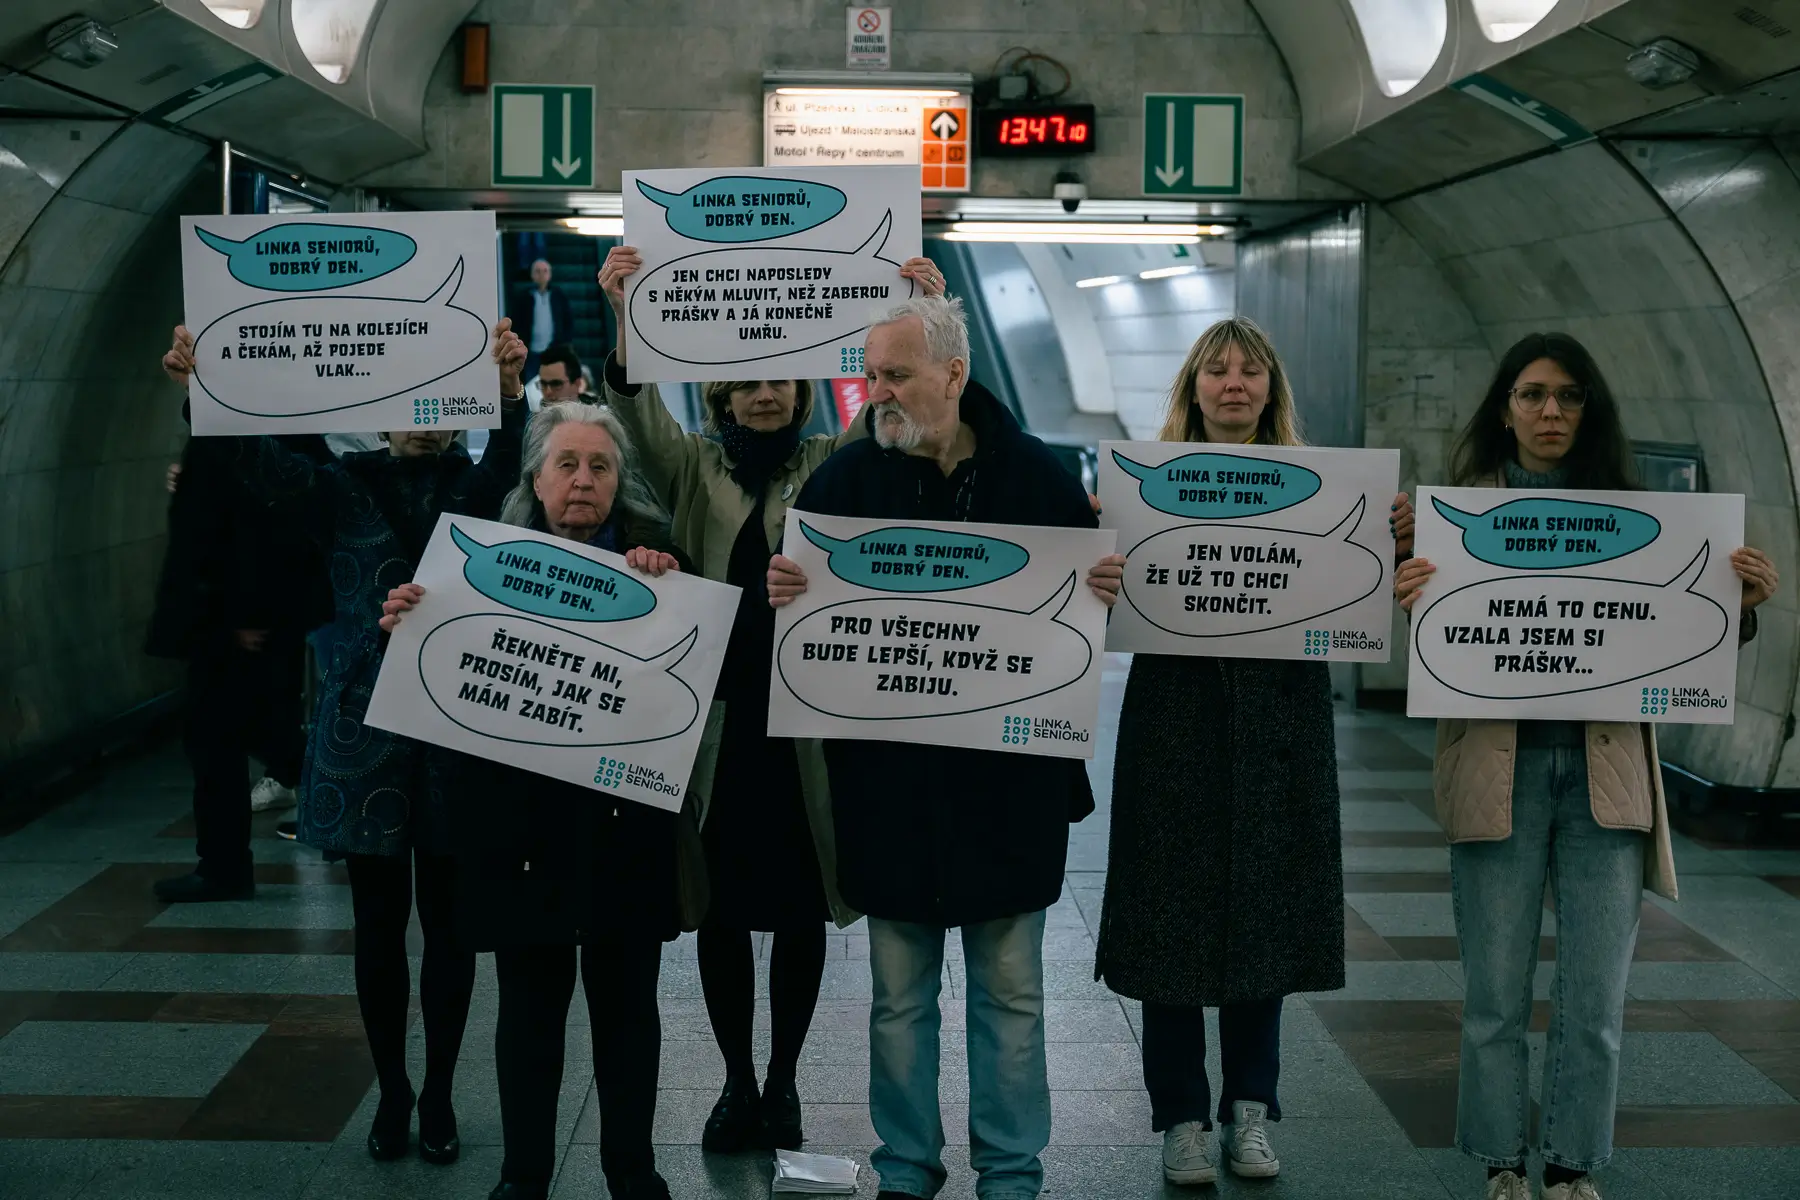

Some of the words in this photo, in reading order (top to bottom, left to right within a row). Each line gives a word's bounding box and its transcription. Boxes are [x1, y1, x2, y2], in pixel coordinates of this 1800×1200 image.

[774, 146, 807, 156] Motol
[856, 148, 904, 157] centrum
[693, 194, 736, 207] LINKA
[742, 188, 811, 208] SENIORŮ,
[705, 210, 754, 227] DOBRÝ
[761, 213, 795, 226] DEN.
[256, 241, 301, 255] LINKA
[306, 235, 380, 256] SENIORŮ,
[269, 257, 321, 275] DOBRÝ
[328, 260, 363, 274] DEN.
[673, 270, 698, 282] JEN
[706, 269, 739, 282] CHCI
[747, 267, 832, 281] NAPOSLEDY
[649, 290, 657, 302] S
[665, 286, 715, 302] NĚKÝM
[723, 288, 781, 303] MLUVIT,
[788, 284, 815, 300] NEŽ
[822, 286, 889, 299] ZABEROU
[662, 305, 719, 322] PRÁŠKY
[726, 308, 735, 320] A
[743, 304, 759, 320] JÁ
[766, 303, 832, 319] KONEČNĚ
[239, 321, 296, 338] STOJÍM
[302, 324, 322, 337] TU
[330, 324, 350, 336] NA
[357, 319, 427, 336] KOLEJÍCH
[739, 327, 786, 340] UMŘU.
[222, 347, 231, 359] A
[239, 342, 296, 361] ČEKÁM,
[303, 341, 322, 357] AŽ
[329, 343, 385, 356] POJEDE
[842, 356, 864, 364] 200
[316, 364, 370, 377] VLAK...
[442, 397, 477, 406] LINKA
[443, 403, 494, 415] SENIORŮ
[1168, 469, 1210, 483] LINKA
[1217, 469, 1285, 490] SENIORŮ,
[1179, 487, 1228, 503] DOBRÝ
[1234, 491, 1267, 505] DEN.
[1493, 516, 1539, 530] LINKA
[1546, 512, 1621, 536] SENIORŮ,
[1505, 534, 1559, 552] DOBRÝ
[1565, 539, 1602, 553] DEN.
[860, 542, 907, 556] LINKA
[914, 544, 990, 564] SENIORŮ,
[1187, 544, 1221, 561] JEN
[1230, 542, 1302, 568] VOLÁM,
[496, 551, 541, 575] LINKA
[547, 565, 618, 600] SENIORŮ,
[871, 560, 925, 576] DOBRÝ
[932, 565, 969, 579] DEN.
[1146, 564, 1169, 584] ŽE
[1178, 565, 1202, 586] UŽ
[1211, 571, 1235, 587] TO
[1244, 572, 1288, 589] CHCI
[502, 574, 556, 599] DOBRÝ
[559, 590, 594, 613] DEN.
[1185, 593, 1271, 614] SKONČIT.
[1488, 595, 1547, 617] NEMÁ
[1557, 601, 1584, 618] TO
[1594, 602, 1655, 620] CENU.
[831, 616, 872, 635] PRO
[882, 615, 980, 641] VŠECHNY
[1306, 630, 1329, 638] 800
[1333, 630, 1367, 640] LINKA
[1445, 626, 1510, 644] VZALA
[1520, 628, 1574, 645] JSEM
[1584, 629, 1604, 646] SI
[1305, 639, 1329, 647] 200
[1333, 638, 1383, 650] SENIORŮ
[491, 628, 585, 673] ŘEKNĚTE
[591, 662, 622, 689] MI,
[803, 643, 858, 661] BUDE
[868, 644, 933, 671] LEPŠÍ,
[943, 649, 998, 671] KDYŽ
[1007, 655, 1033, 674] SE
[1495, 650, 1592, 674] PRÁŠKY...
[459, 653, 543, 696] PROSÍM,
[552, 680, 592, 704] JAK
[598, 693, 626, 714] SE
[877, 674, 957, 696] ZABIJU.
[1642, 688, 1669, 696] 800
[1673, 688, 1710, 697] LINKA
[458, 682, 510, 711] MÁM
[519, 699, 582, 733] ZABÍT.
[1642, 697, 1668, 705] 200
[1672, 696, 1727, 708] SENIORŮ
[1641, 706, 1667, 715] 007
[1004, 716, 1030, 726] 800
[1035, 718, 1071, 730] LINKA
[1004, 726, 1030, 735] 200
[1033, 728, 1089, 742] SENIORŮ
[1002, 735, 1028, 745] 007
[594, 766, 622, 783] 200
[599, 757, 625, 774] 800
[594, 776, 620, 788] 007
[626, 764, 664, 786] LINKA
[626, 773, 680, 796] SENIORŮ
